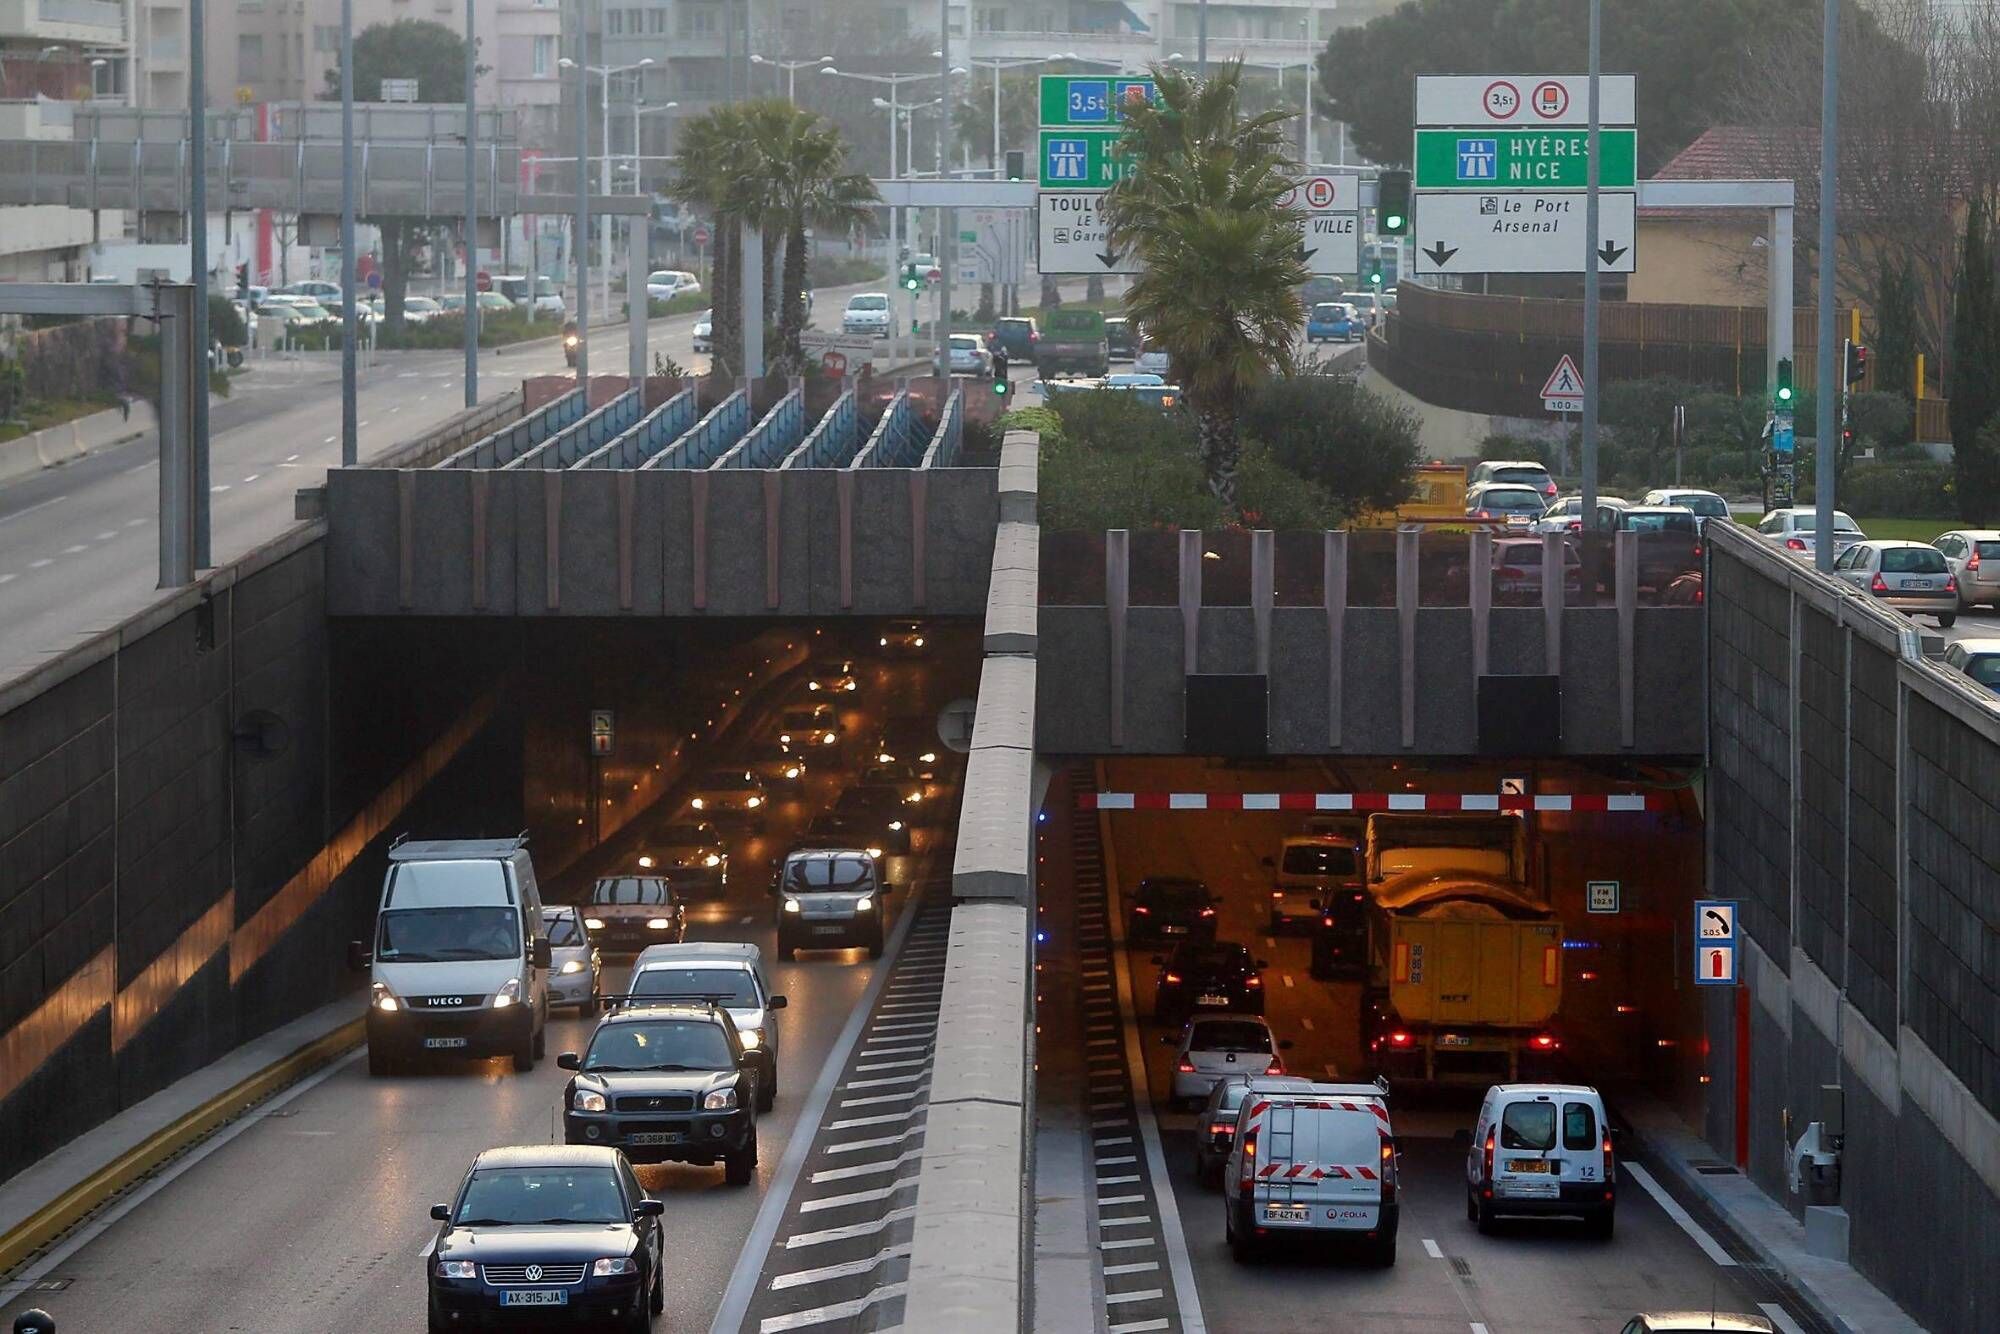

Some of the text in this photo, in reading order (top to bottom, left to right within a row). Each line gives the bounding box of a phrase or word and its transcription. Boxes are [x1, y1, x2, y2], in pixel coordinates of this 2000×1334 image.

[1510, 162, 1561, 180] NICE
[1504, 199, 1570, 213] Le Port
[1077, 215, 1092, 227] LE
[1314, 219, 1354, 234] VILLE
[1492, 219, 1559, 233] Arsenal
[1072, 230, 1105, 242] Gare
[1552, 401, 1571, 409] 100
[428, 997, 463, 1006] IVECO
[1581, 1166, 1596, 1177] 12
[507, 1291, 561, 1304] AX-315-JA
